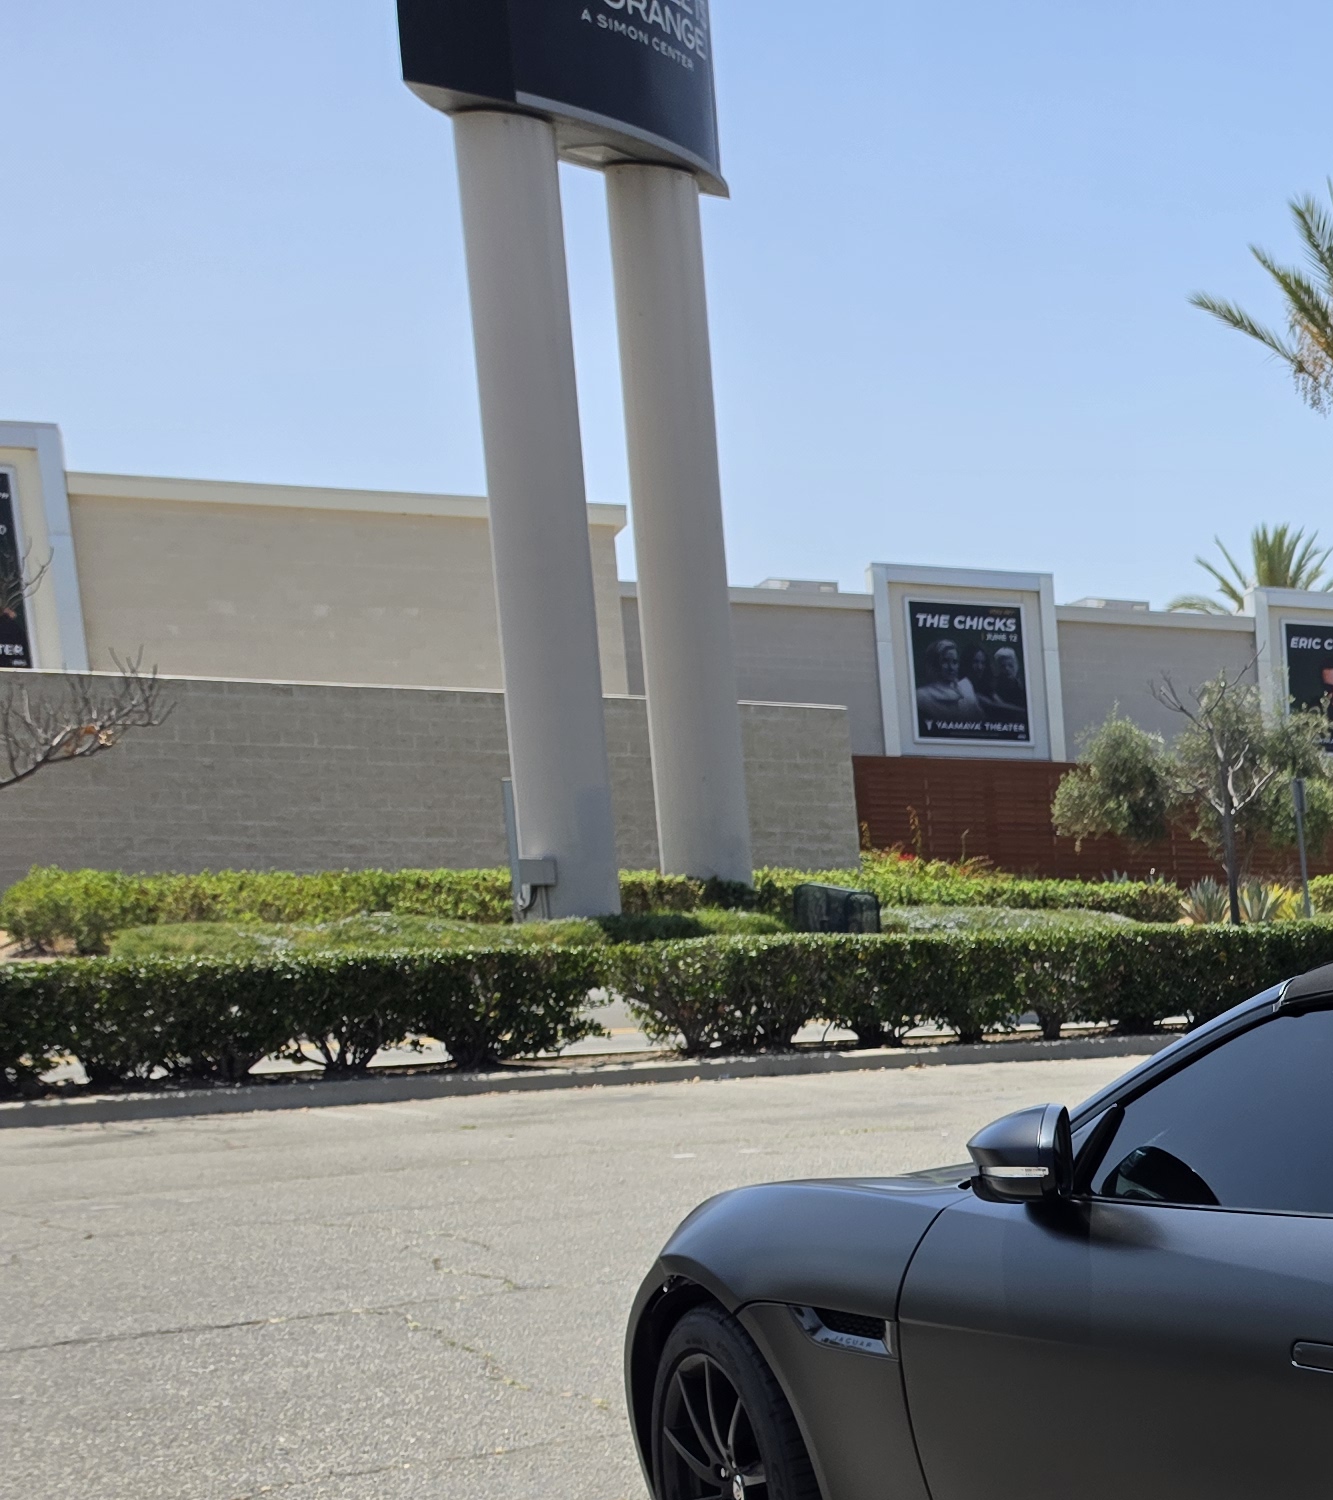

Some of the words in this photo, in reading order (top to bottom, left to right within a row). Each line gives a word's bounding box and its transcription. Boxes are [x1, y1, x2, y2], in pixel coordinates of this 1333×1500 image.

[581, 8, 592, 23] A
[597, 13, 649, 46] SIMON
[652, 37, 694, 72] CENTER
[916, 613, 950, 628] THE
[953, 615, 1017, 632] CHICKS
[1290, 637, 1321, 650] ERIC
[984, 722, 1025, 732] THEATER
[834, 1336, 873, 1348] JAGUAR
